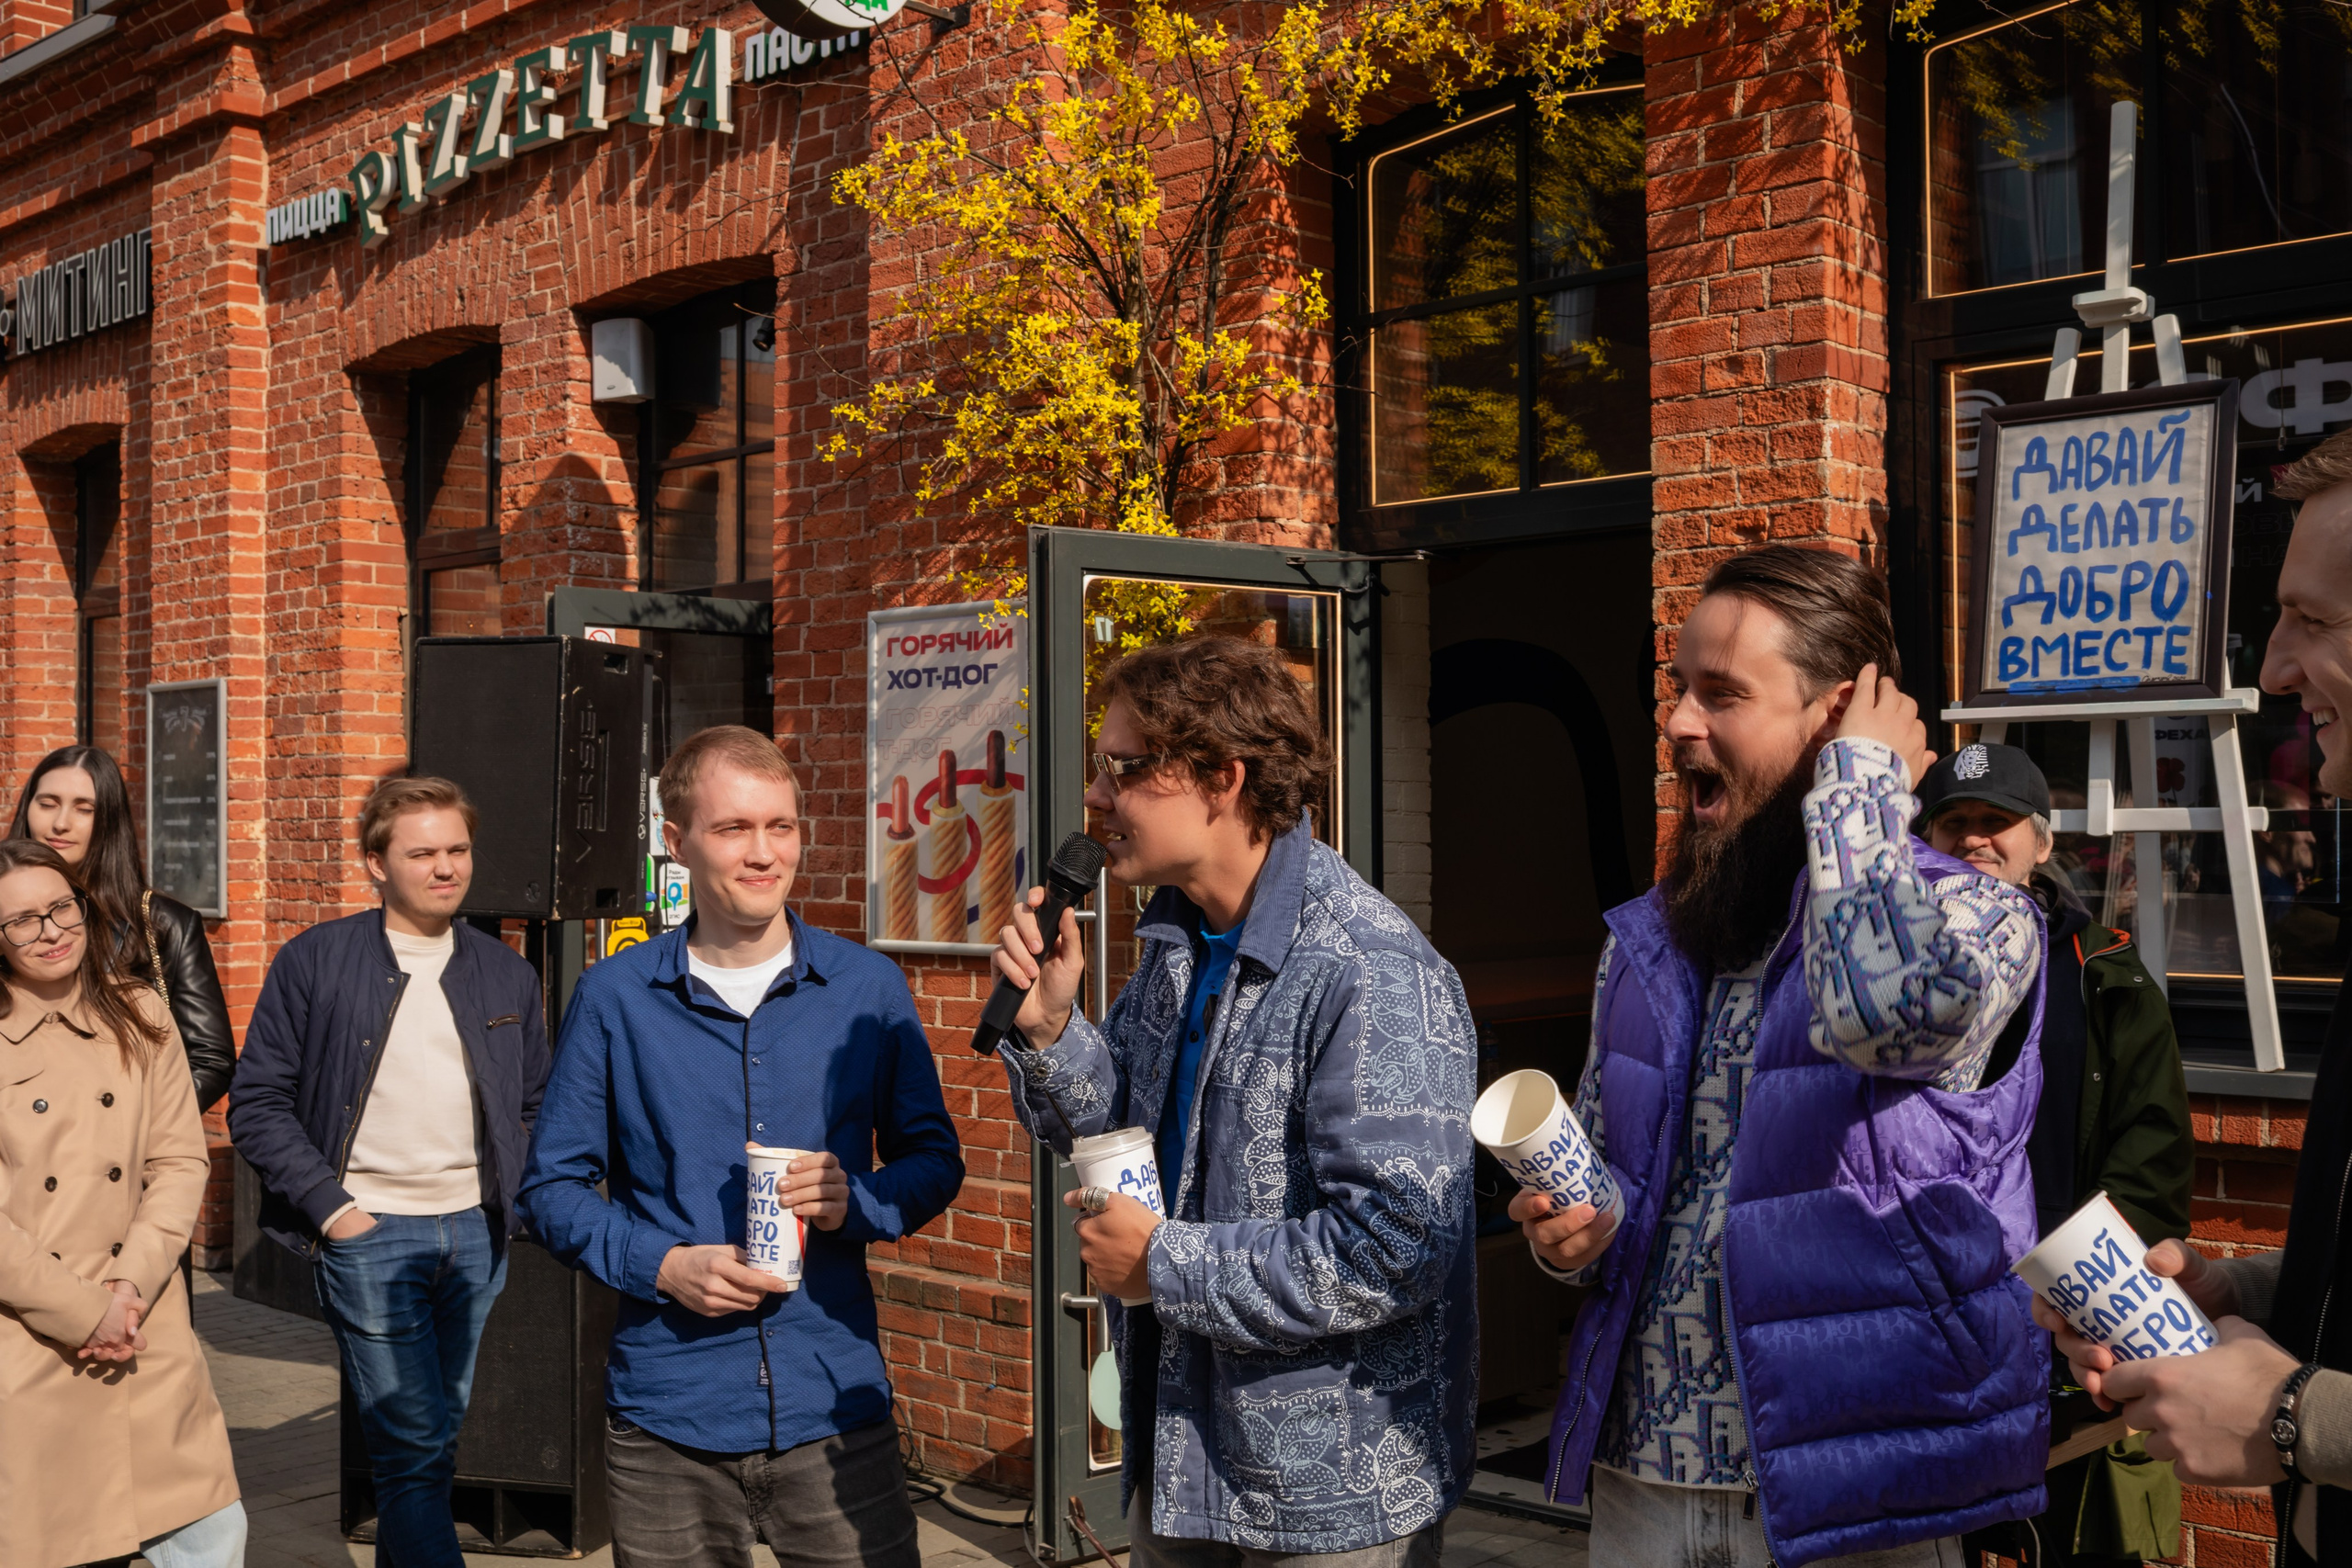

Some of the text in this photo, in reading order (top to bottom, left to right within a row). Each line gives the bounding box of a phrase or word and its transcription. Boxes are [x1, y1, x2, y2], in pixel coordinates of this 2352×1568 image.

[349, 26, 734, 248] PIZZETTA
[266, 186, 341, 244] ПИЦЦА
[2012, 409, 2191, 502] ДАВАЙ
[2007, 496, 2196, 558] ДЕЛАТЬ
[2001, 559, 2190, 630] ДОБРО
[887, 623, 1013, 658] ГОРЯЧИЙ
[1997, 626, 2192, 682] ВМЕСТЕ
[887, 663, 998, 690] ХОТ-ДОГ
[886, 697, 1015, 730] ГОРЯЧИЙ
